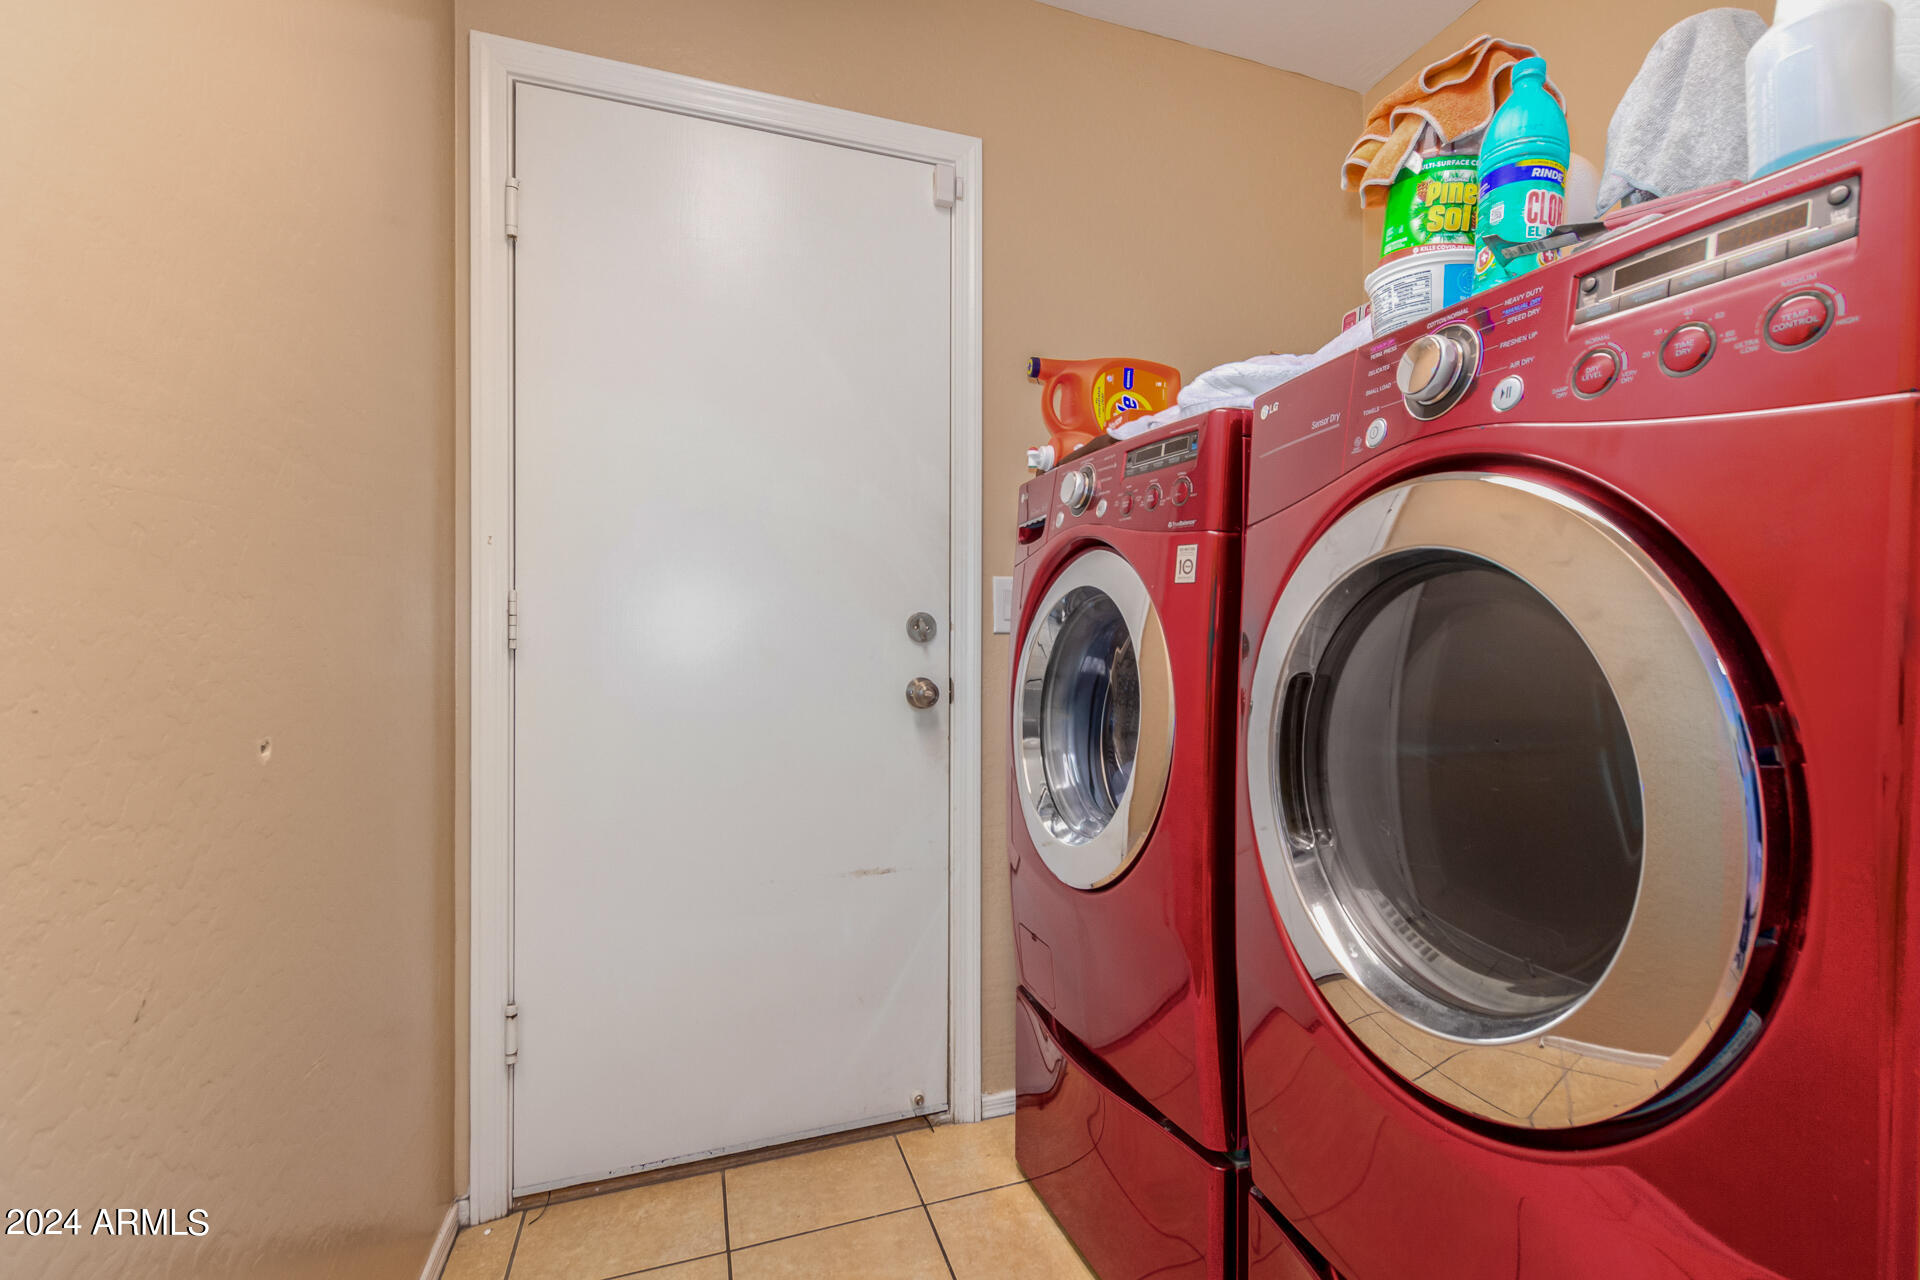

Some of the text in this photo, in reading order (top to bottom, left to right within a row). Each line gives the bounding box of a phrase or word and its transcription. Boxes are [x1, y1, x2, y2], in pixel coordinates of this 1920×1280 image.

[1426, 204, 1472, 233] Sol
[1528, 226, 1542, 237] EL
[1504, 286, 1544, 306] HEAVY DUTY
[1507, 307, 1541, 325] SPEED DRY
[1781, 309, 1809, 321] TEMP
[1772, 316, 1819, 333] CONTROL
[1500, 335, 1528, 349] FRESHEN
[1675, 347, 1692, 357] DRY
[1510, 360, 1520, 369] AIR
[1311, 413, 1341, 430] Sensor Dry
